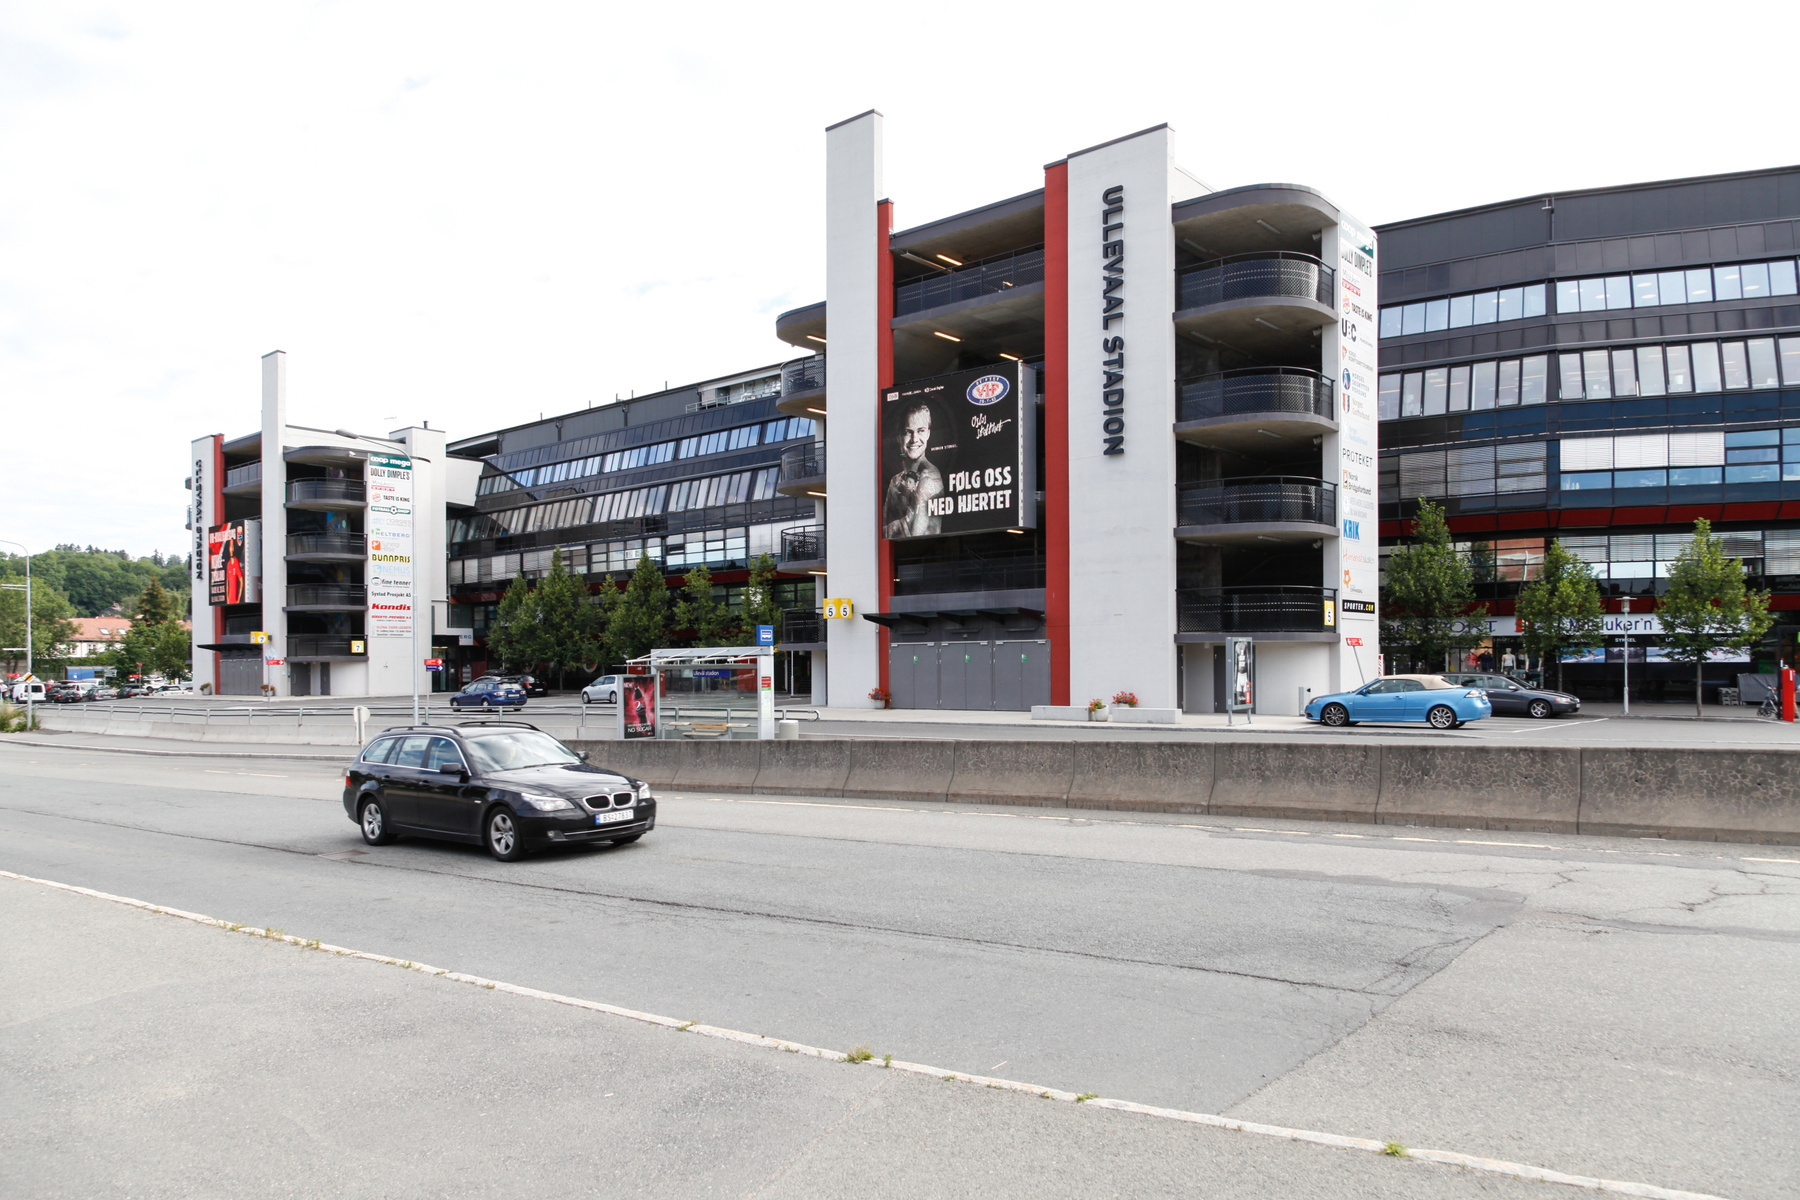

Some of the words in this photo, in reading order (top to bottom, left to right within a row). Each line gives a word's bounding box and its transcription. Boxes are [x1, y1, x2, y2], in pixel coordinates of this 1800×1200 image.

[1102, 184, 1124, 331] ULLEVAAL
[1354, 251, 1373, 278] DIMPLE'S
[1103, 335, 1125, 456] STADION
[370, 456, 389, 464] coop
[390, 458, 411, 468] mega
[1342, 447, 1373, 468] PROTEKET
[370, 468, 386, 478] DOLLY
[387, 470, 410, 480] DIMPLE'S
[949, 470, 981, 493] FØLG
[984, 466, 1012, 487] OSS
[1348, 472, 1359, 482] Norsk
[927, 497, 954, 517] MED
[957, 489, 1012, 514] HJERTET
[1343, 518, 1360, 540] KRIK
[195, 526, 204, 580] STADION
[371, 553, 411, 563] BUNNPRIS
[382, 564, 411, 574] NEMUS
[371, 590, 386, 598] Systad
[828, 607, 834, 617] 5
[842, 607, 848, 617] 5
[1327, 611, 1332, 623] 5
